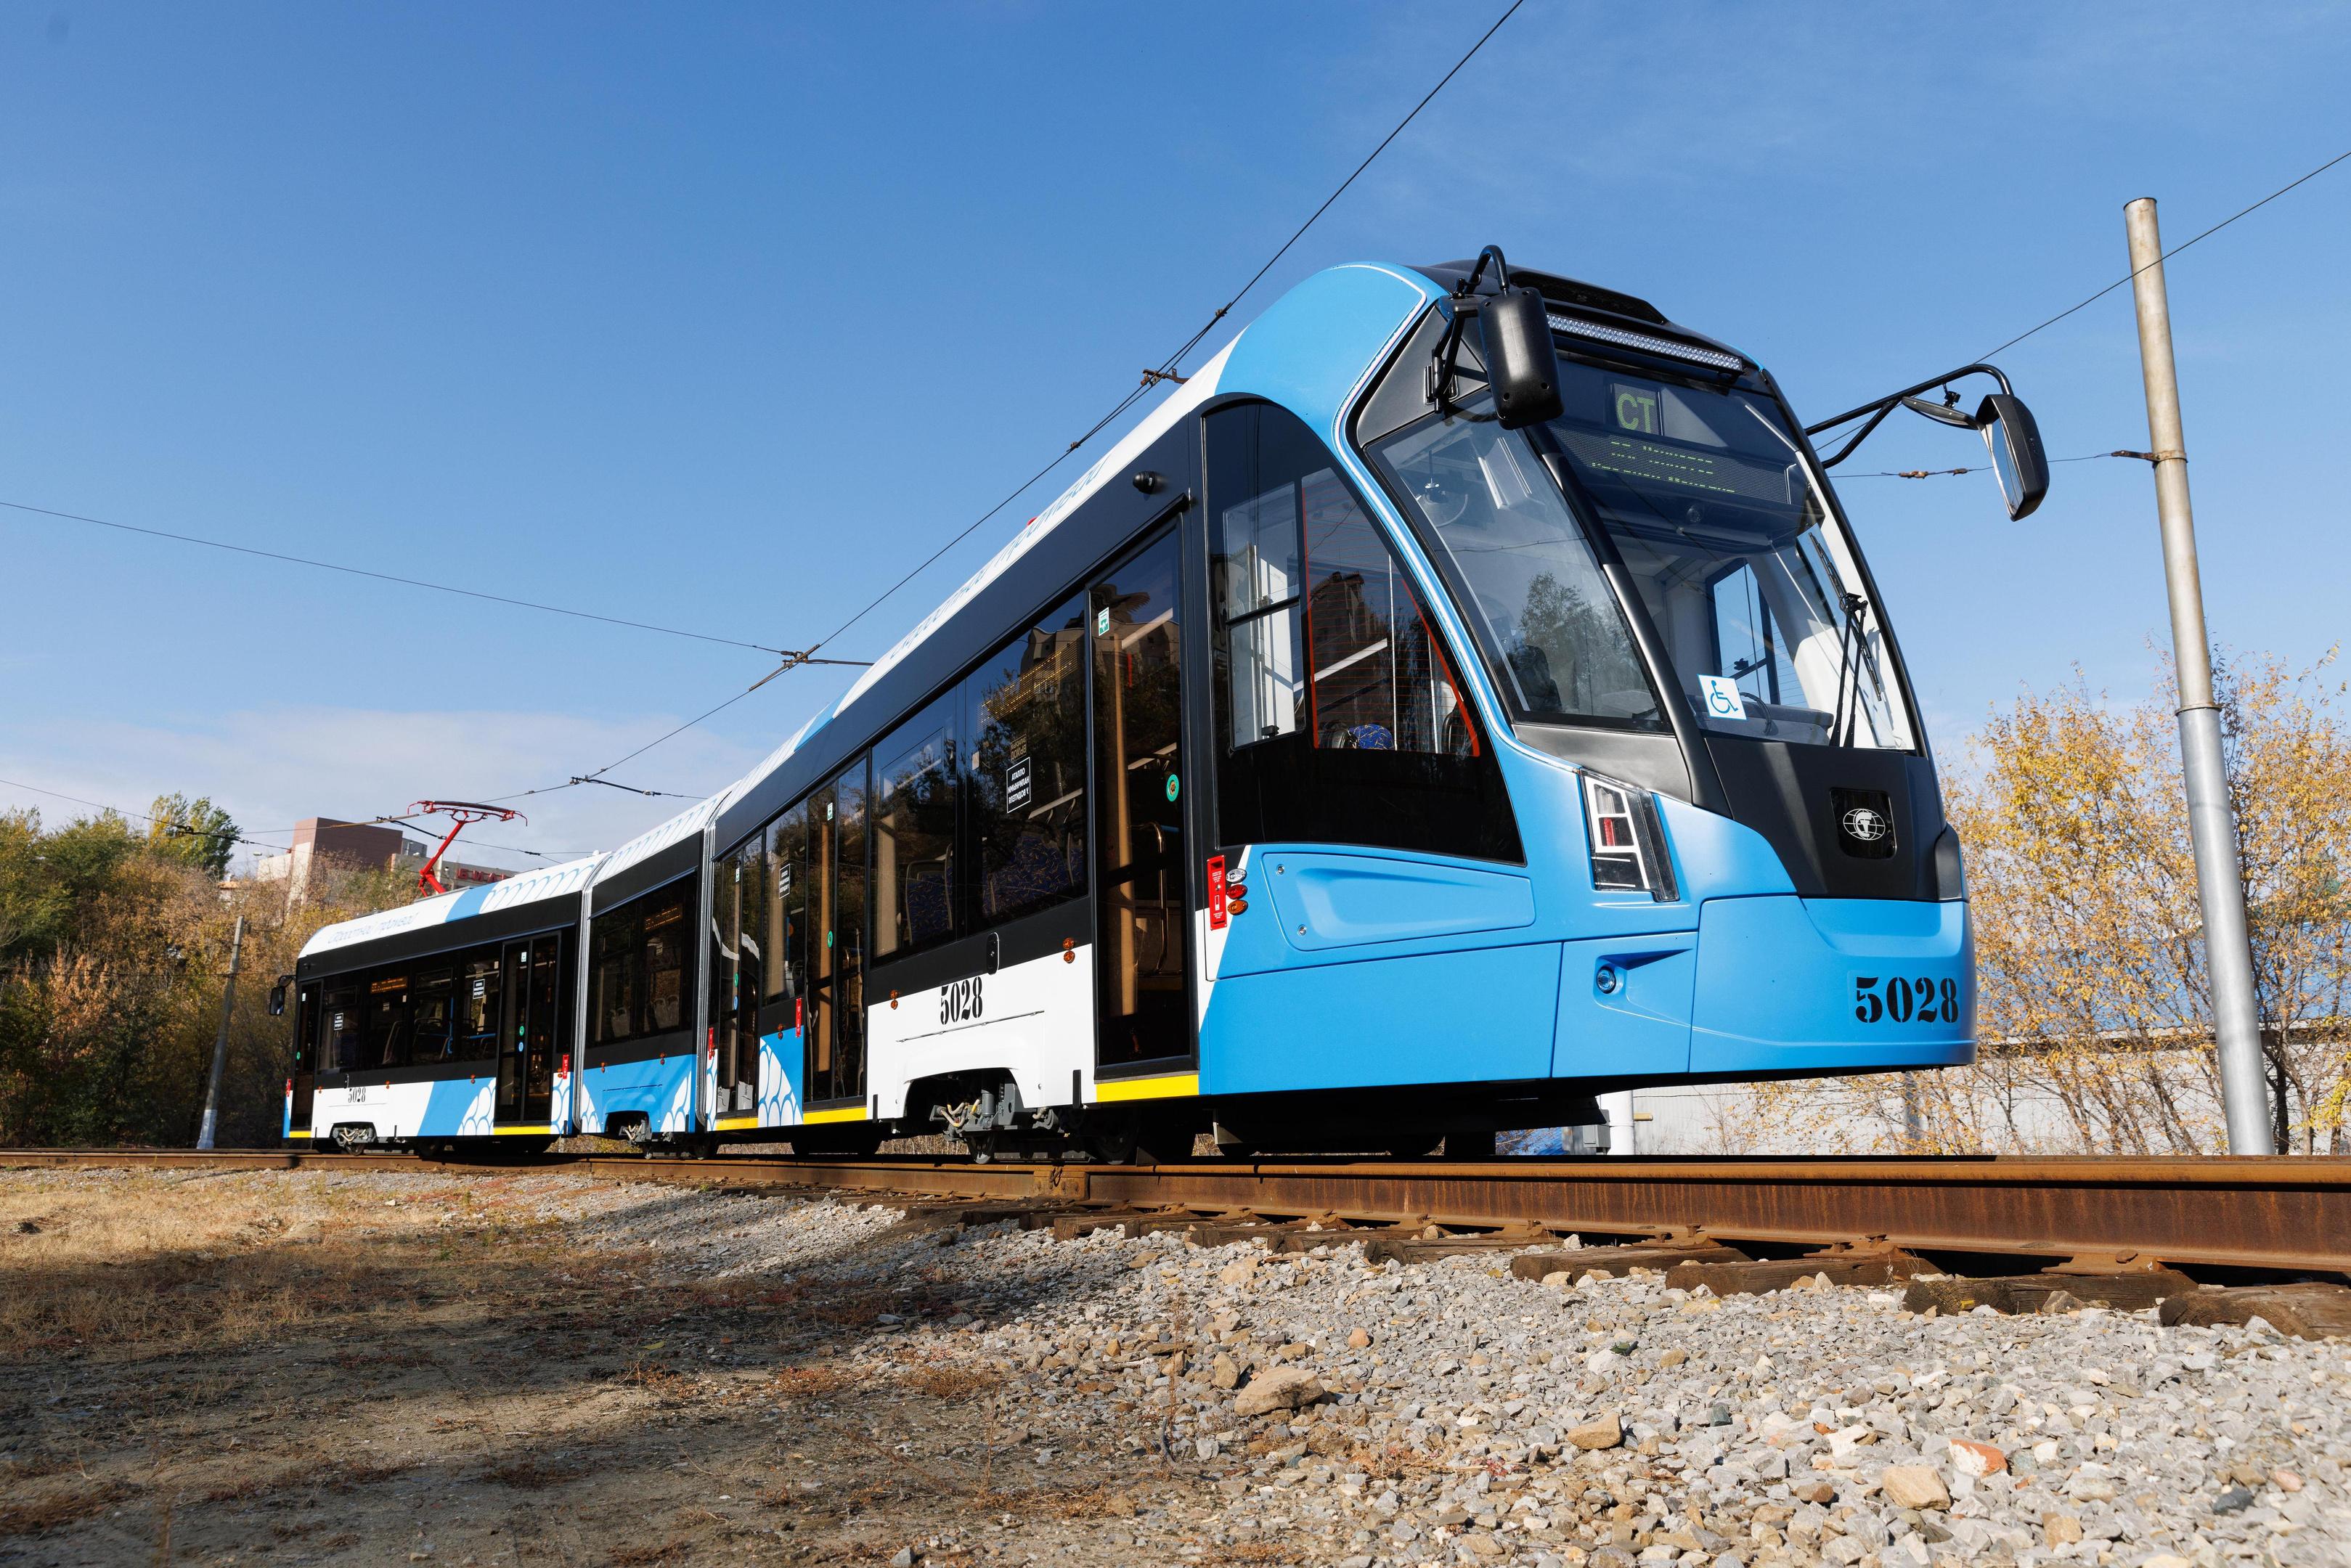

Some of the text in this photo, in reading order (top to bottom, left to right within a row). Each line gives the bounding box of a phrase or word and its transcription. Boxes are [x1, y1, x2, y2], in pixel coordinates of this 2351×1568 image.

[940, 976, 983, 1025] 5028
[1855, 976, 1958, 1023] 5028
[348, 1087, 366, 1103] 5028
